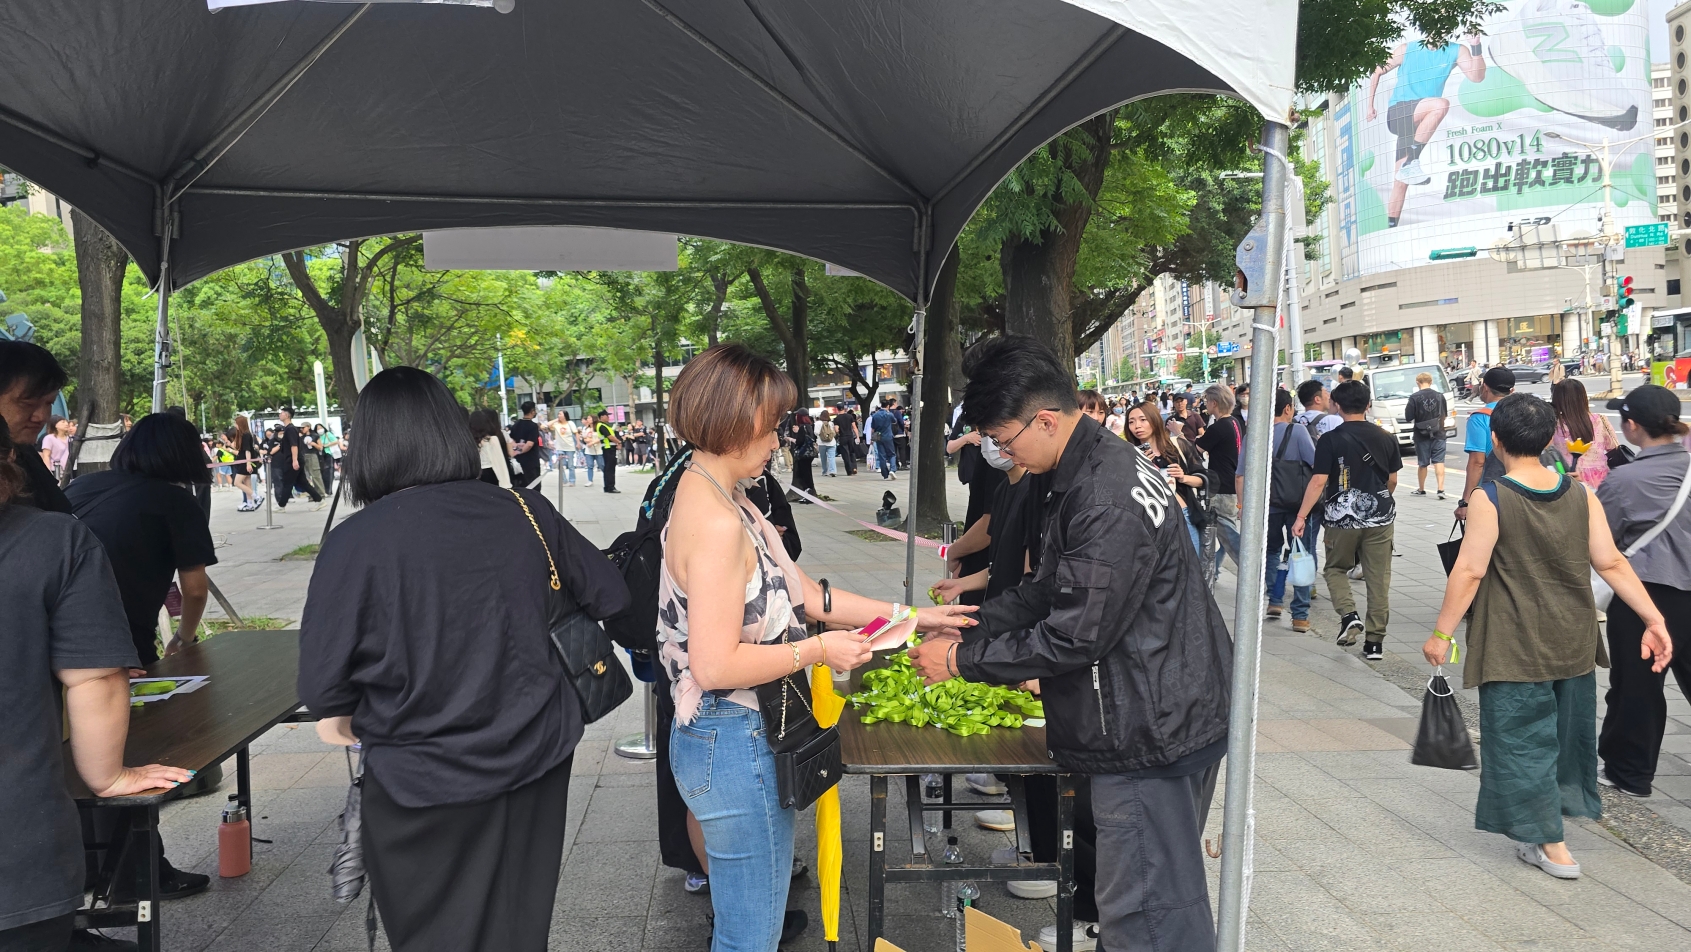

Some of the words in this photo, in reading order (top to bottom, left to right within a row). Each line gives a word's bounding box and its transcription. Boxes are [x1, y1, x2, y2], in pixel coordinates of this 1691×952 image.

[1446, 127, 1468, 138] Fresh
[1471, 124, 1493, 134] Foam
[1496, 122, 1503, 130] X
[1446, 128, 1544, 166] 1080v14
[1443, 152, 1604, 201] 跑出軟實力
